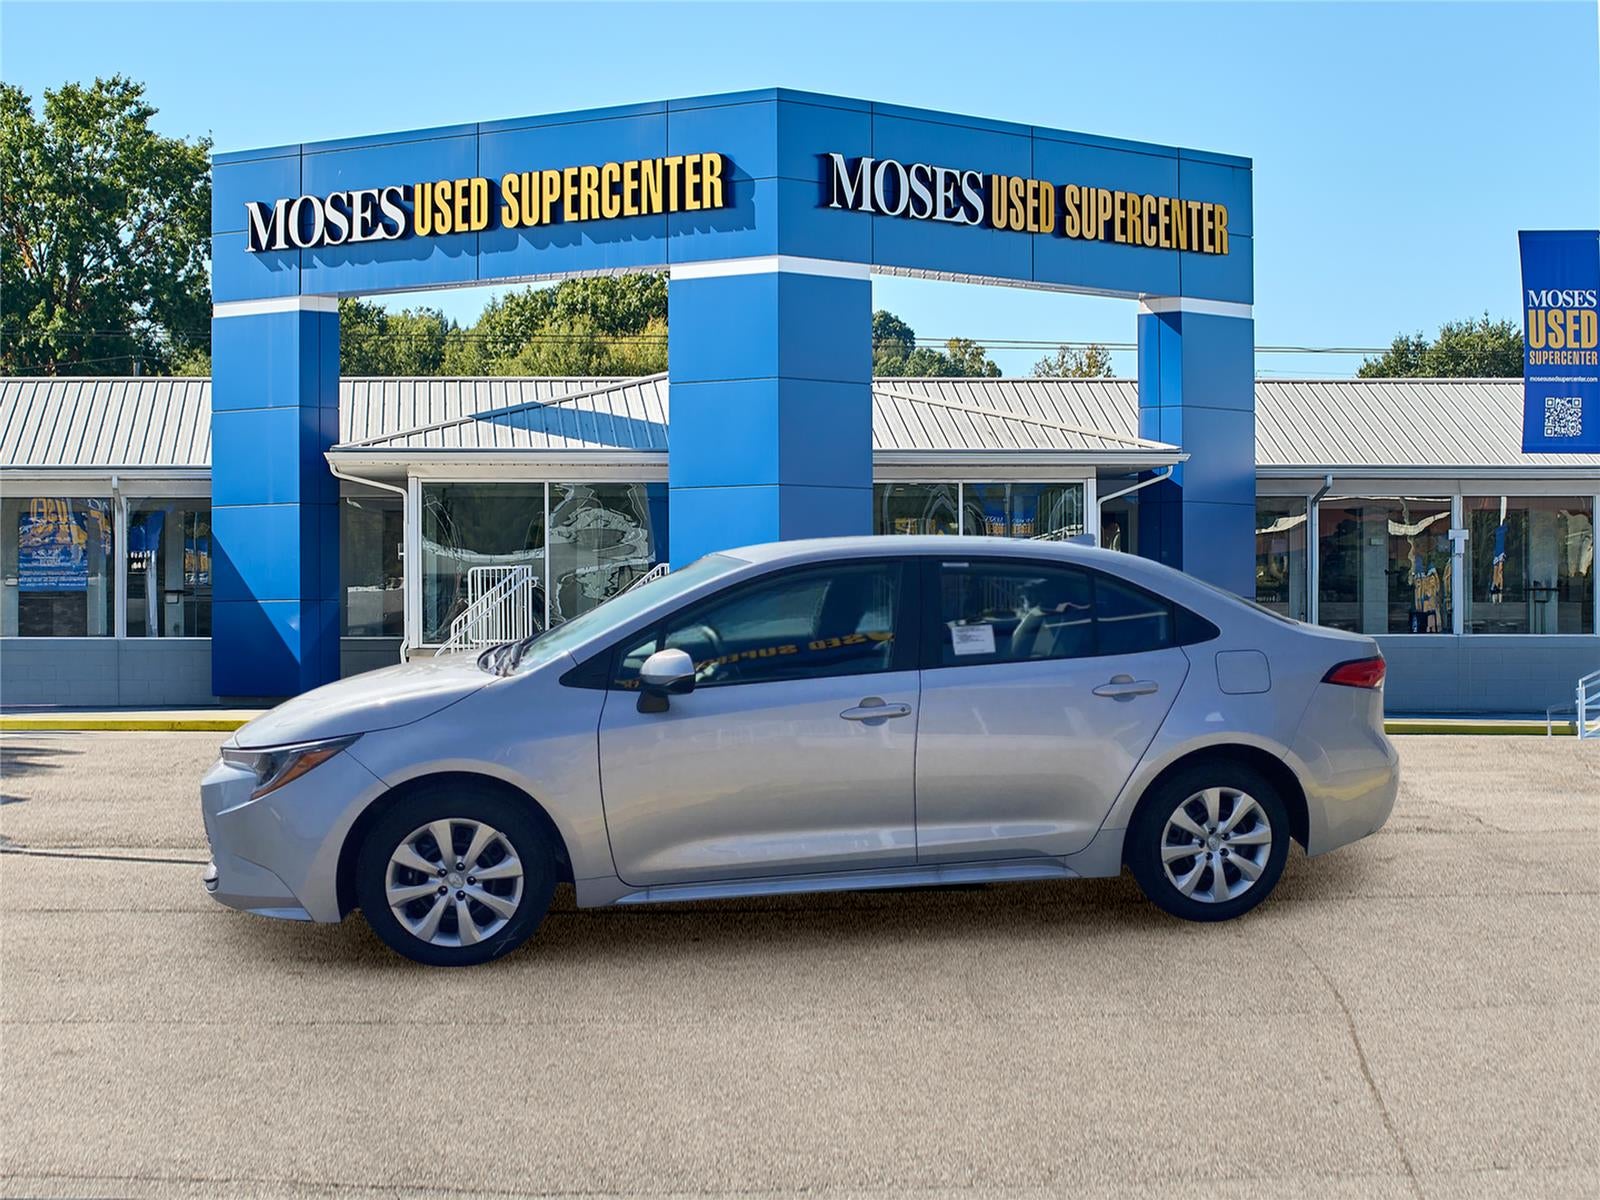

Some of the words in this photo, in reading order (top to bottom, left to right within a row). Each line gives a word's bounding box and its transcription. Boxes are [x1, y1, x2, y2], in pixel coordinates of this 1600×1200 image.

[244, 185, 406, 254] MOSES
[413, 177, 489, 238] USED
[500, 151, 725, 229] SUPERCENTER
[828, 152, 985, 226] MOSES
[991, 173, 1056, 234] USED
[1065, 183, 1230, 255] SUPERCENTER
[1527, 289, 1597, 308] MOSES
[1528, 309, 1598, 349] USED
[1529, 350, 1598, 365] SUPERCENTER
